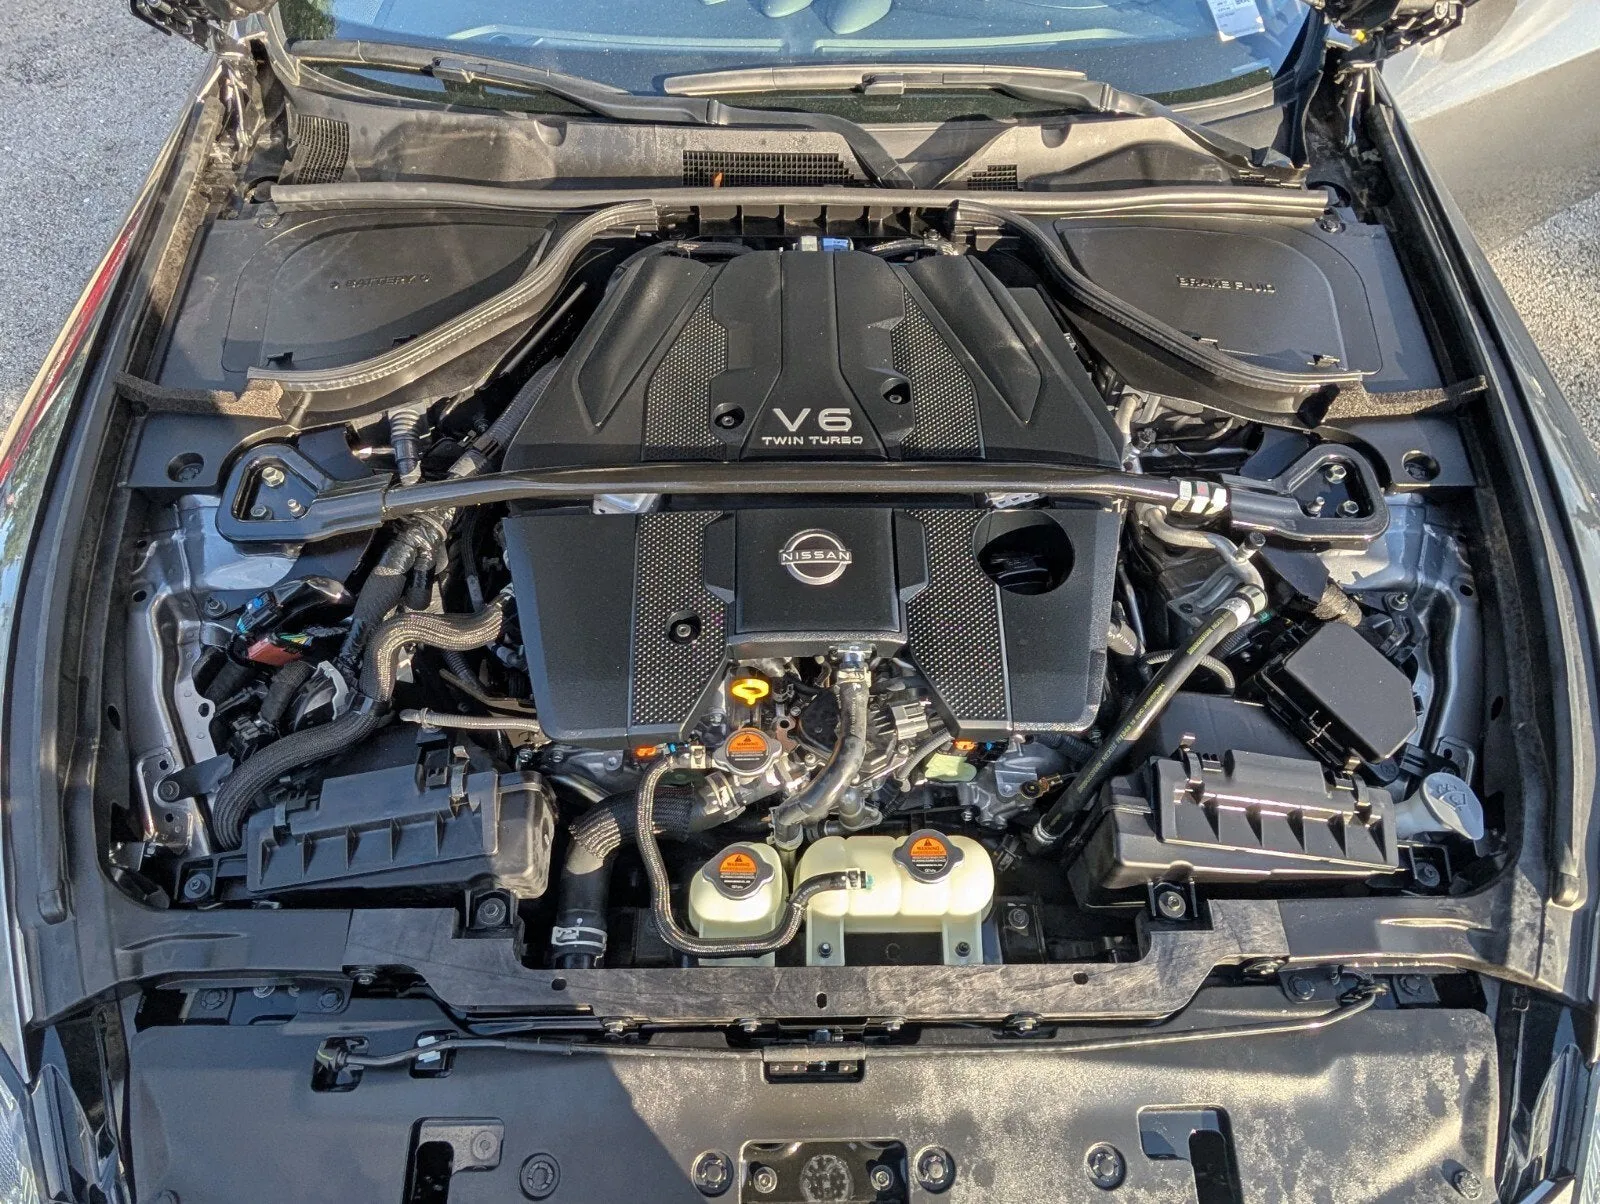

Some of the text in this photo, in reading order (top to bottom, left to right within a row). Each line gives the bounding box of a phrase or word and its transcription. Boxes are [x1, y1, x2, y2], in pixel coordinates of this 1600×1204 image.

[1177, 275, 1276, 294] BRAKE FLUID
[761, 435, 864, 446] TWIN TURBO
[781, 550, 851, 561] NISSAN
